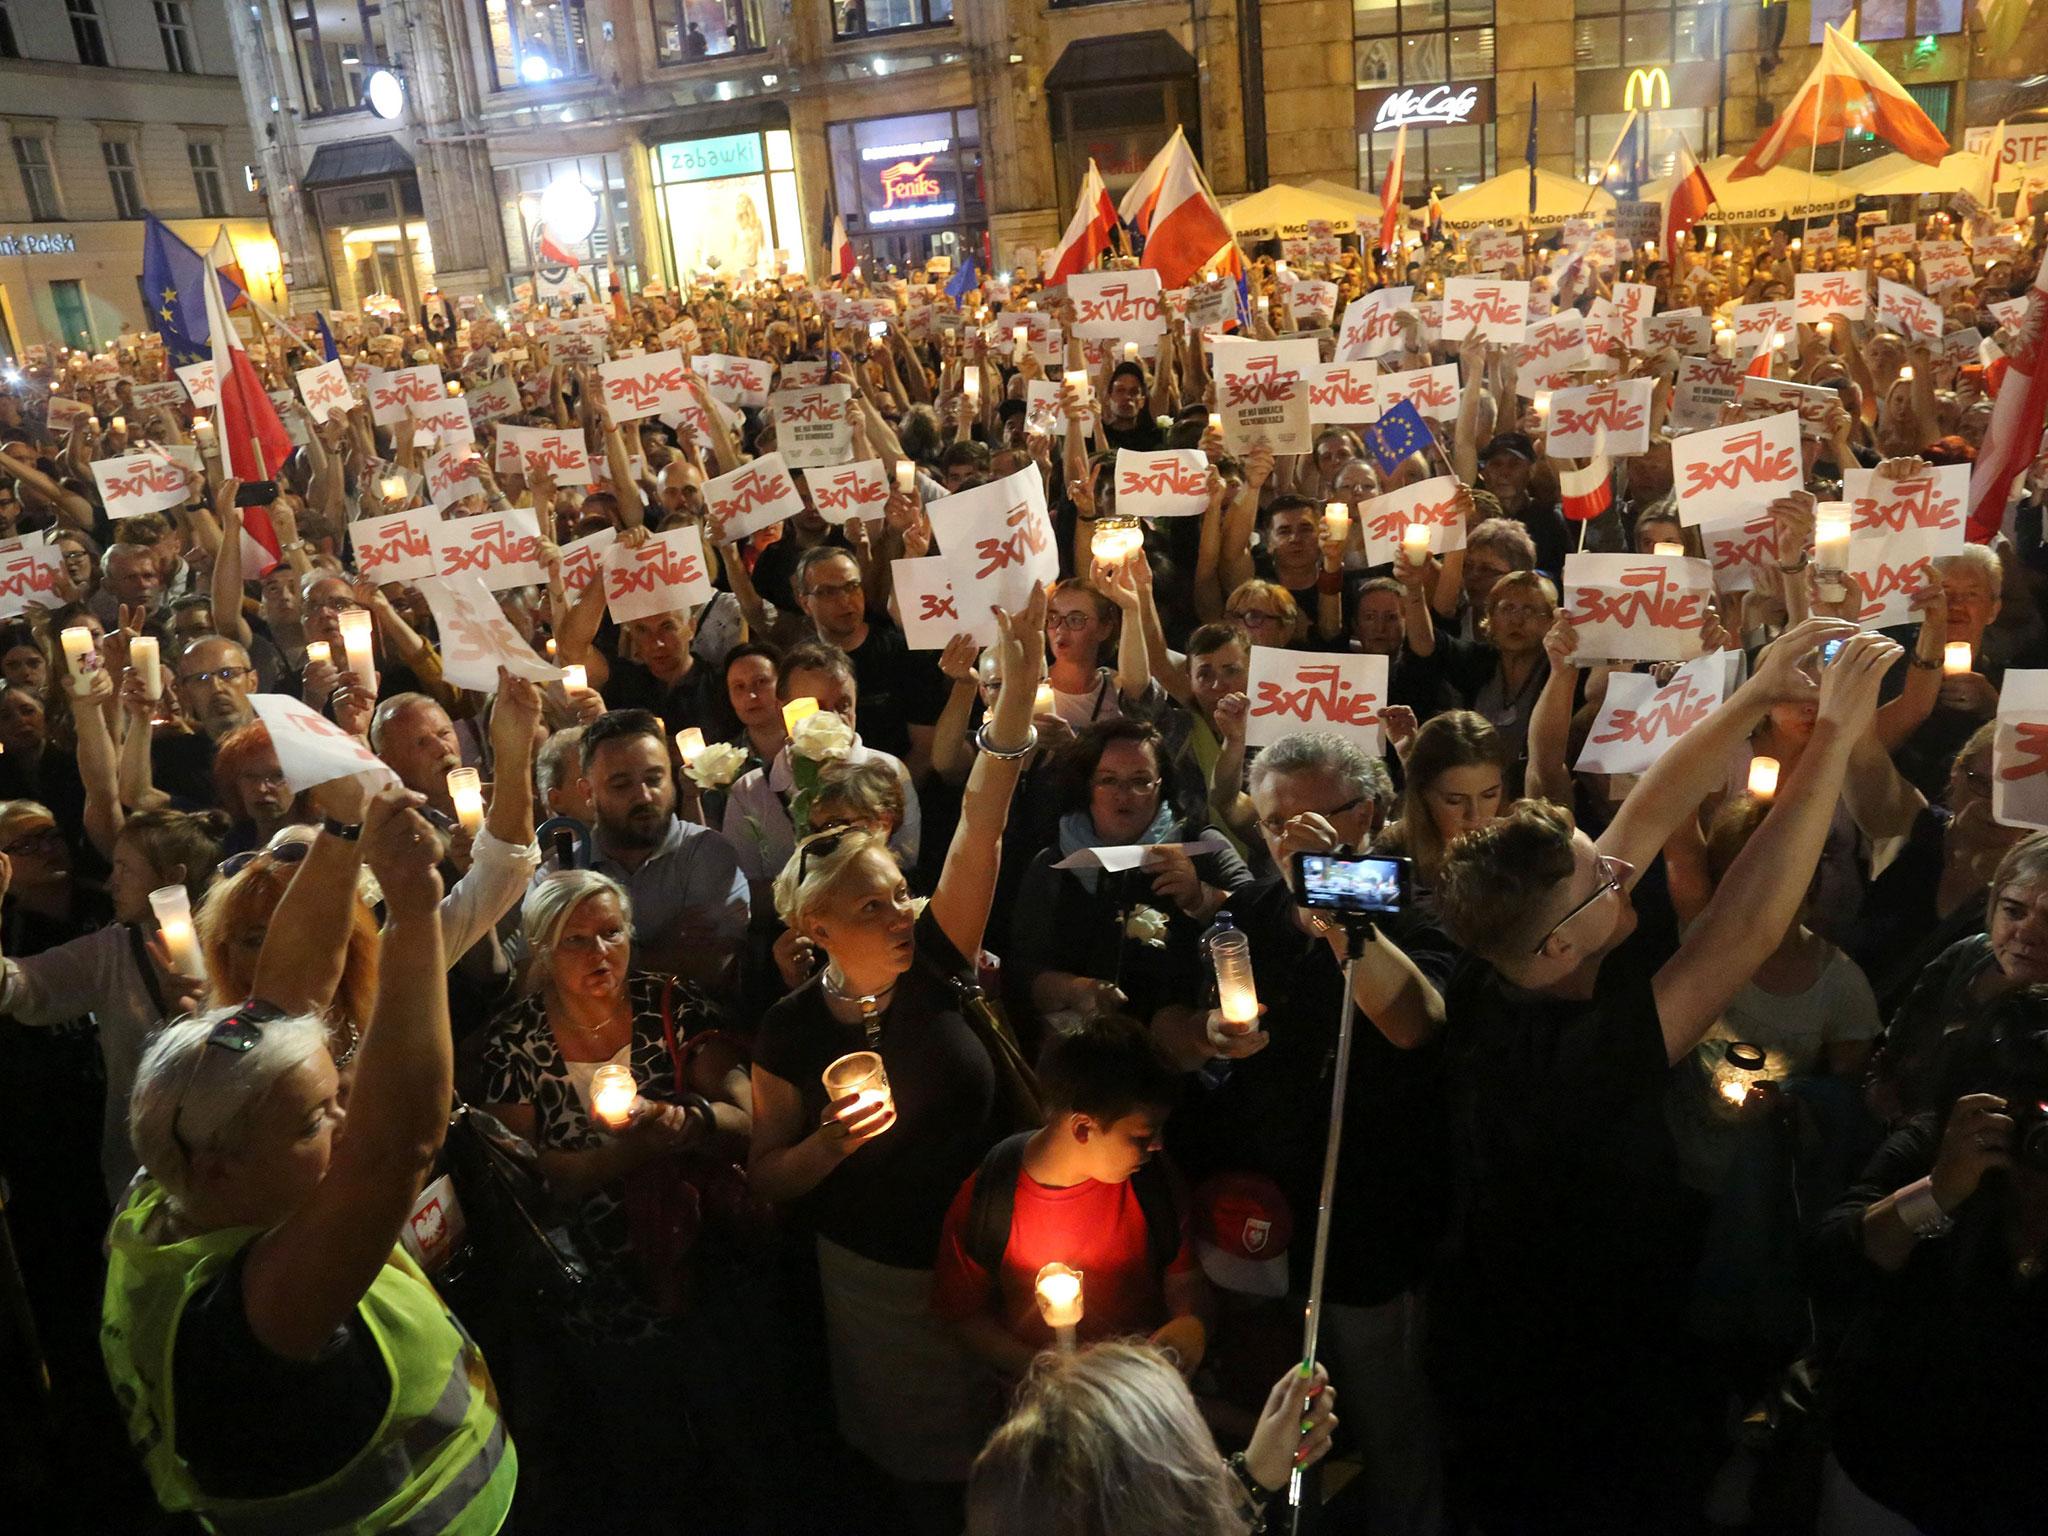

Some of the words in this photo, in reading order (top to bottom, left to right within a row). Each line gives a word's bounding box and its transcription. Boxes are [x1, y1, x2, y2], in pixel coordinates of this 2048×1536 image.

[671, 142, 754, 169] zabawki
[881, 172, 941, 208] Feniks
[26, 233, 76, 254] Polski
[610, 541, 702, 601] 3xNiE
[1566, 566, 1704, 629] 3xNiE
[1250, 664, 1380, 727] 3xNiE
